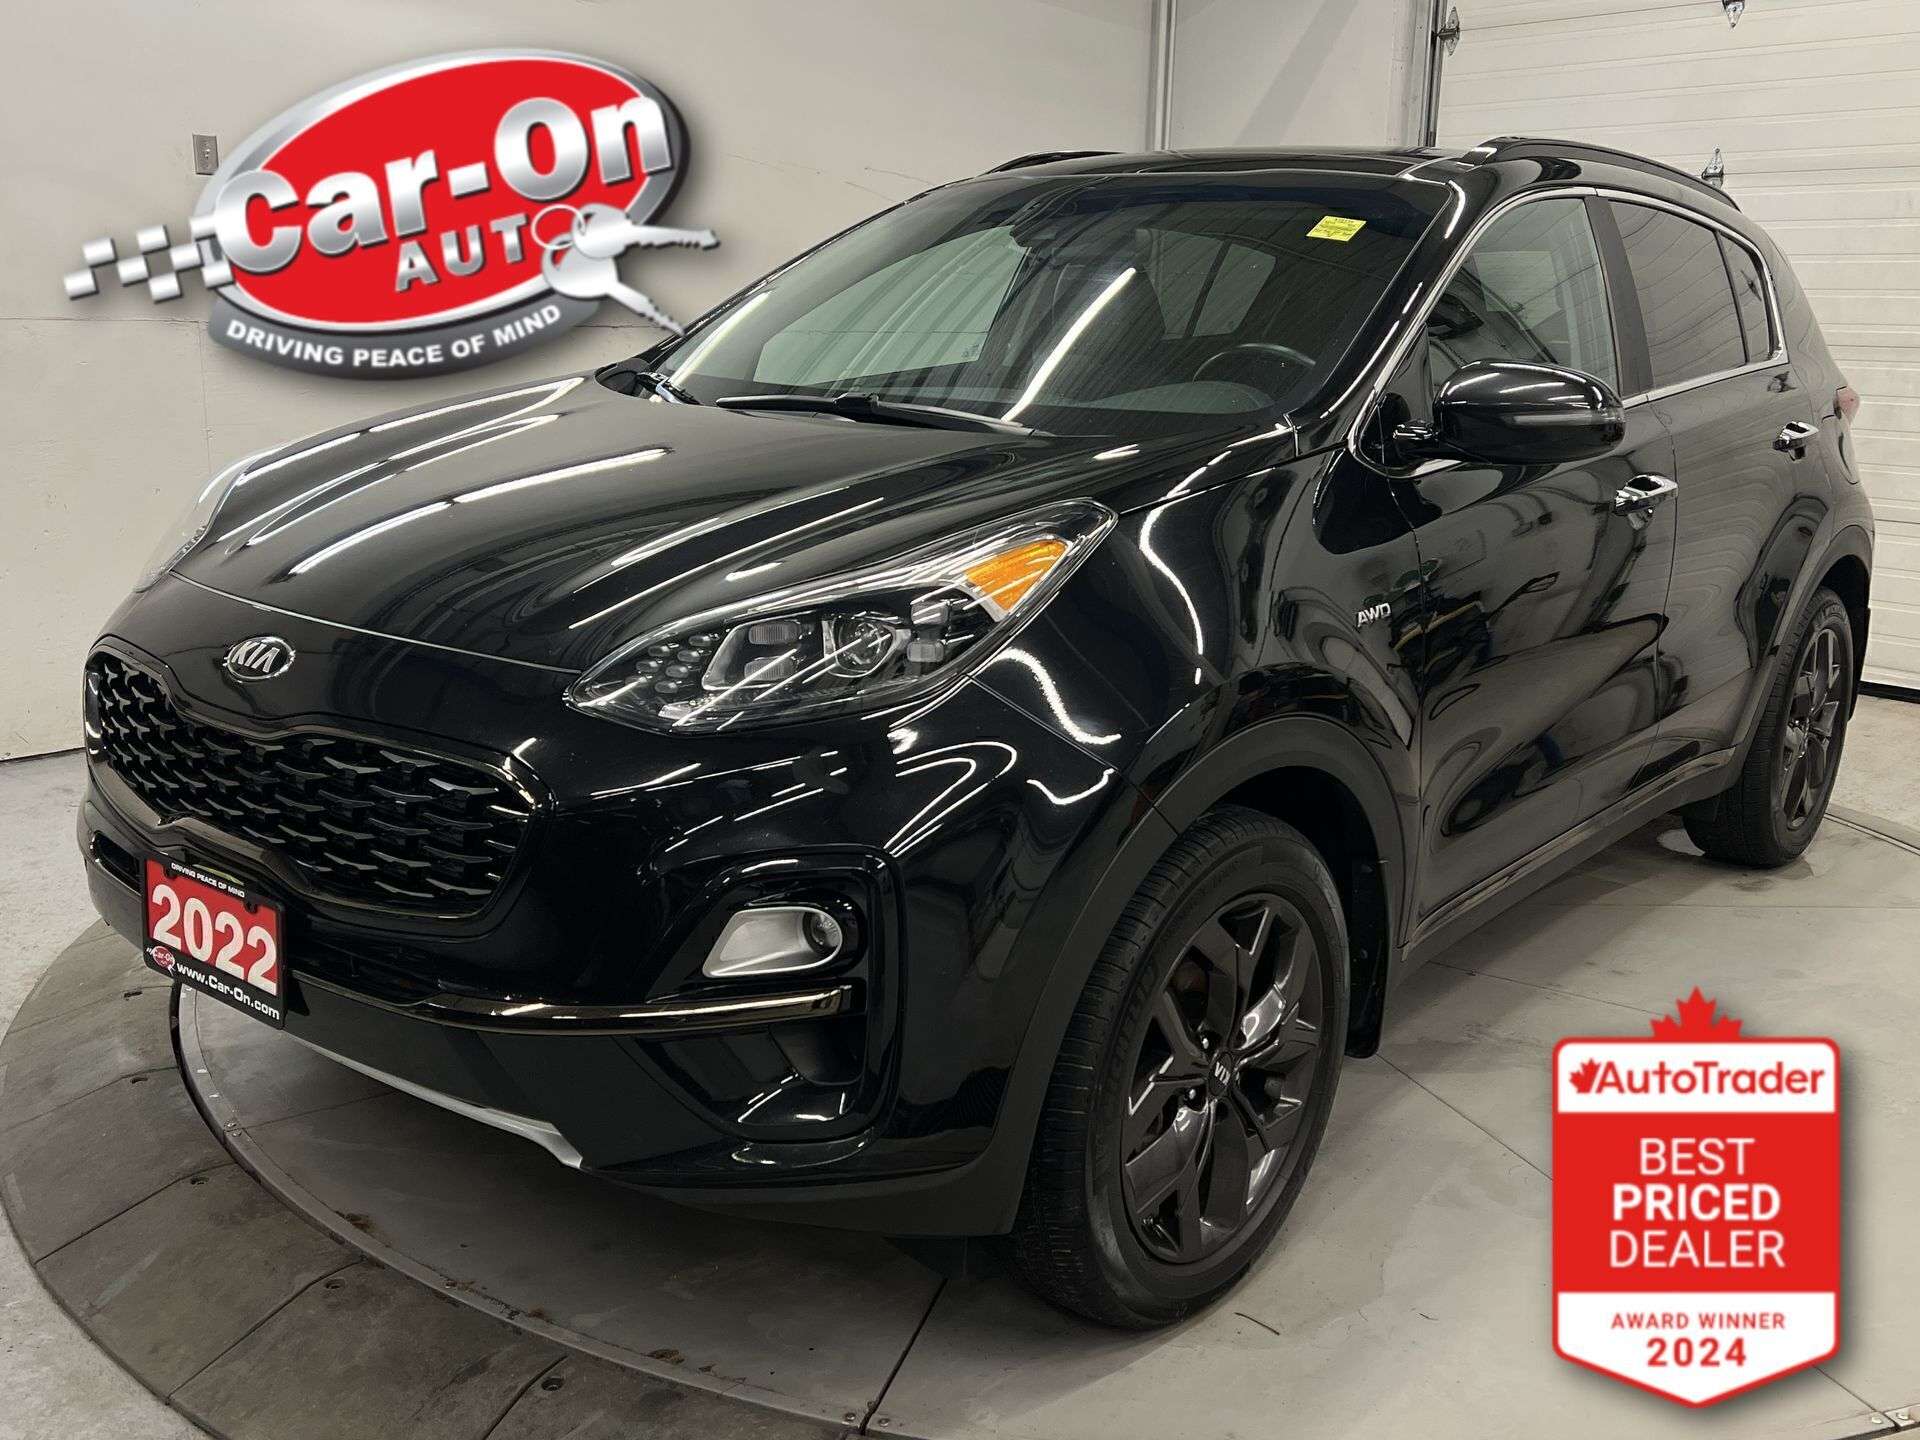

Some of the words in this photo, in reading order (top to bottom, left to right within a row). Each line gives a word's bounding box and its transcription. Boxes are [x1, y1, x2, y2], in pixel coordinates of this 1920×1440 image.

[1357, 602, 1392, 628] AWD
[231, 640, 280, 673] KIA
[171, 862, 196, 878] DRIVING
[196, 873, 217, 887] PEACE
[217, 881, 227, 890] OF
[227, 886, 245, 898] MIND
[152, 883, 278, 997] 2022
[176, 962, 280, 1021] www.Car-On.com
